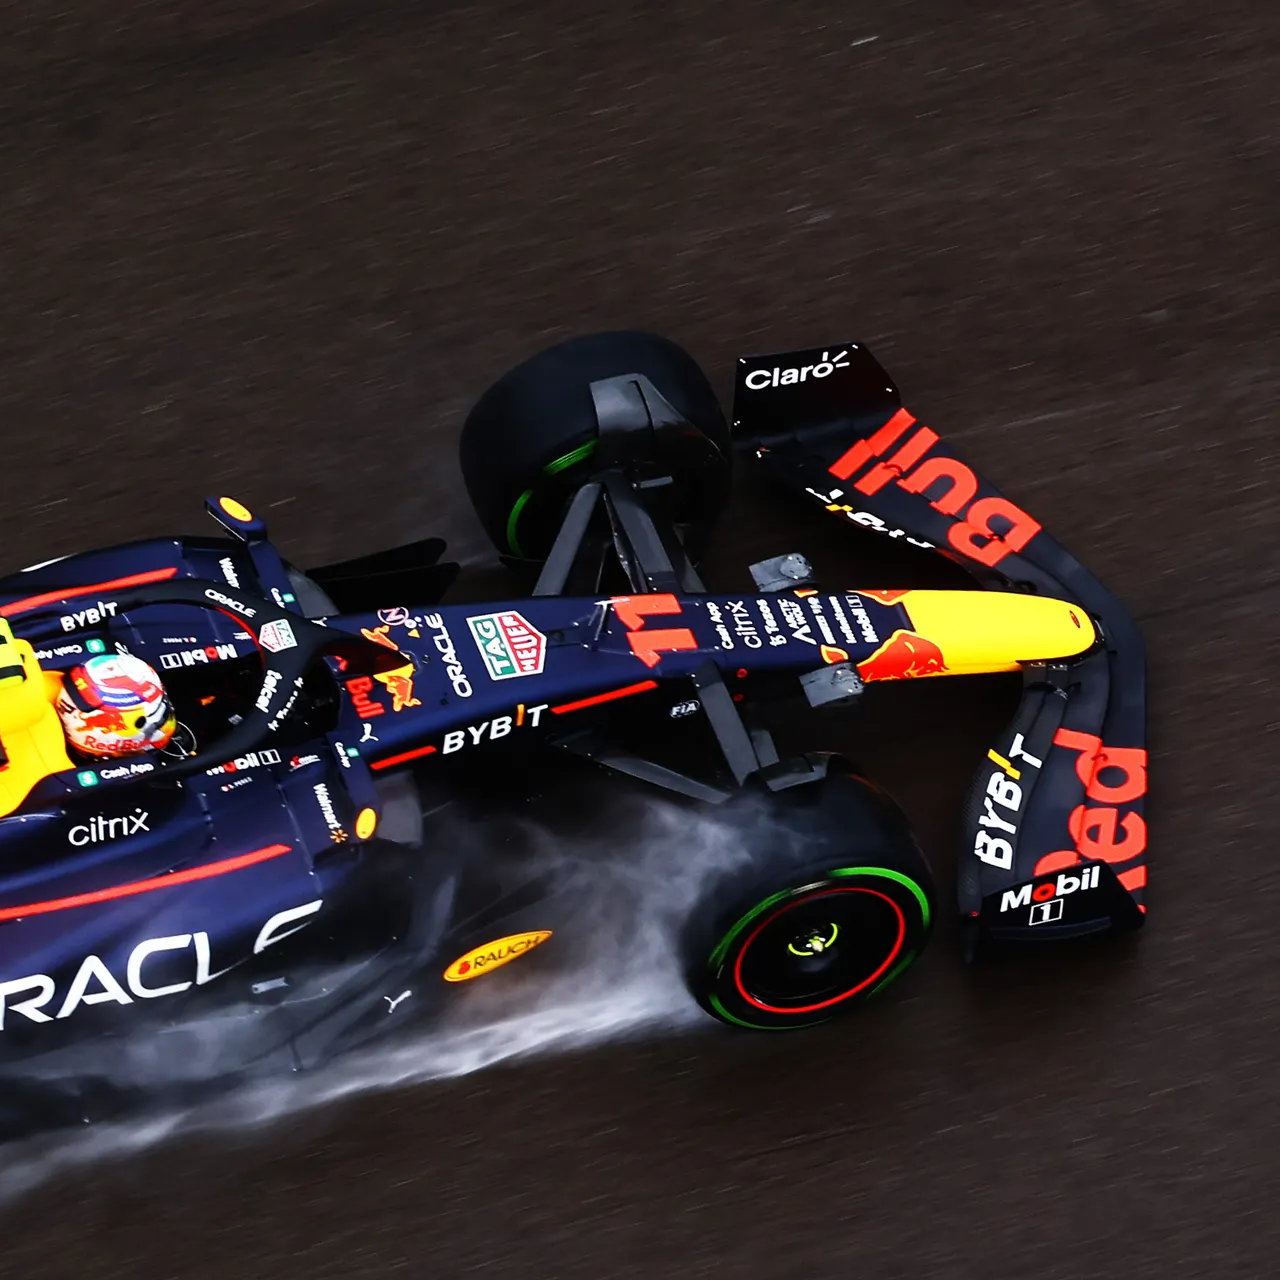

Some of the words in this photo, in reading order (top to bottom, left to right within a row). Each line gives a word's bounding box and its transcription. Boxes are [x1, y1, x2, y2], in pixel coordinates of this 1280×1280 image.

[745, 357, 837, 389] Claro
[828, 407, 1042, 567] Bull
[219, 557, 240, 589] Walm
[60, 601, 118, 632] BYBIT
[205, 589, 257, 618] ORACLE
[706, 602, 723, 624] App
[756, 599, 779, 634] Tezos
[777, 599, 800, 629] ARCTIC
[790, 601, 807, 626] WOLF
[609, 592, 698, 668] 11
[715, 624, 734, 649] Cash
[724, 600, 762, 648] citrix
[851, 608, 879, 643] Mobil
[180, 643, 238, 666] Mobil
[424, 612, 473, 698] ORACLE
[476, 620, 512, 676] TAG
[502, 614, 538, 672] HEUER
[345, 675, 386, 719] Bull
[442, 704, 548, 755] BYBIT
[100, 766, 130, 780] Cash
[313, 783, 342, 830] Walmart
[974, 733, 1042, 870] BYBIT
[68, 808, 150, 846] citrix
[1000, 866, 1100, 912] Mobil
[473, 935, 540, 969] RAUCH
